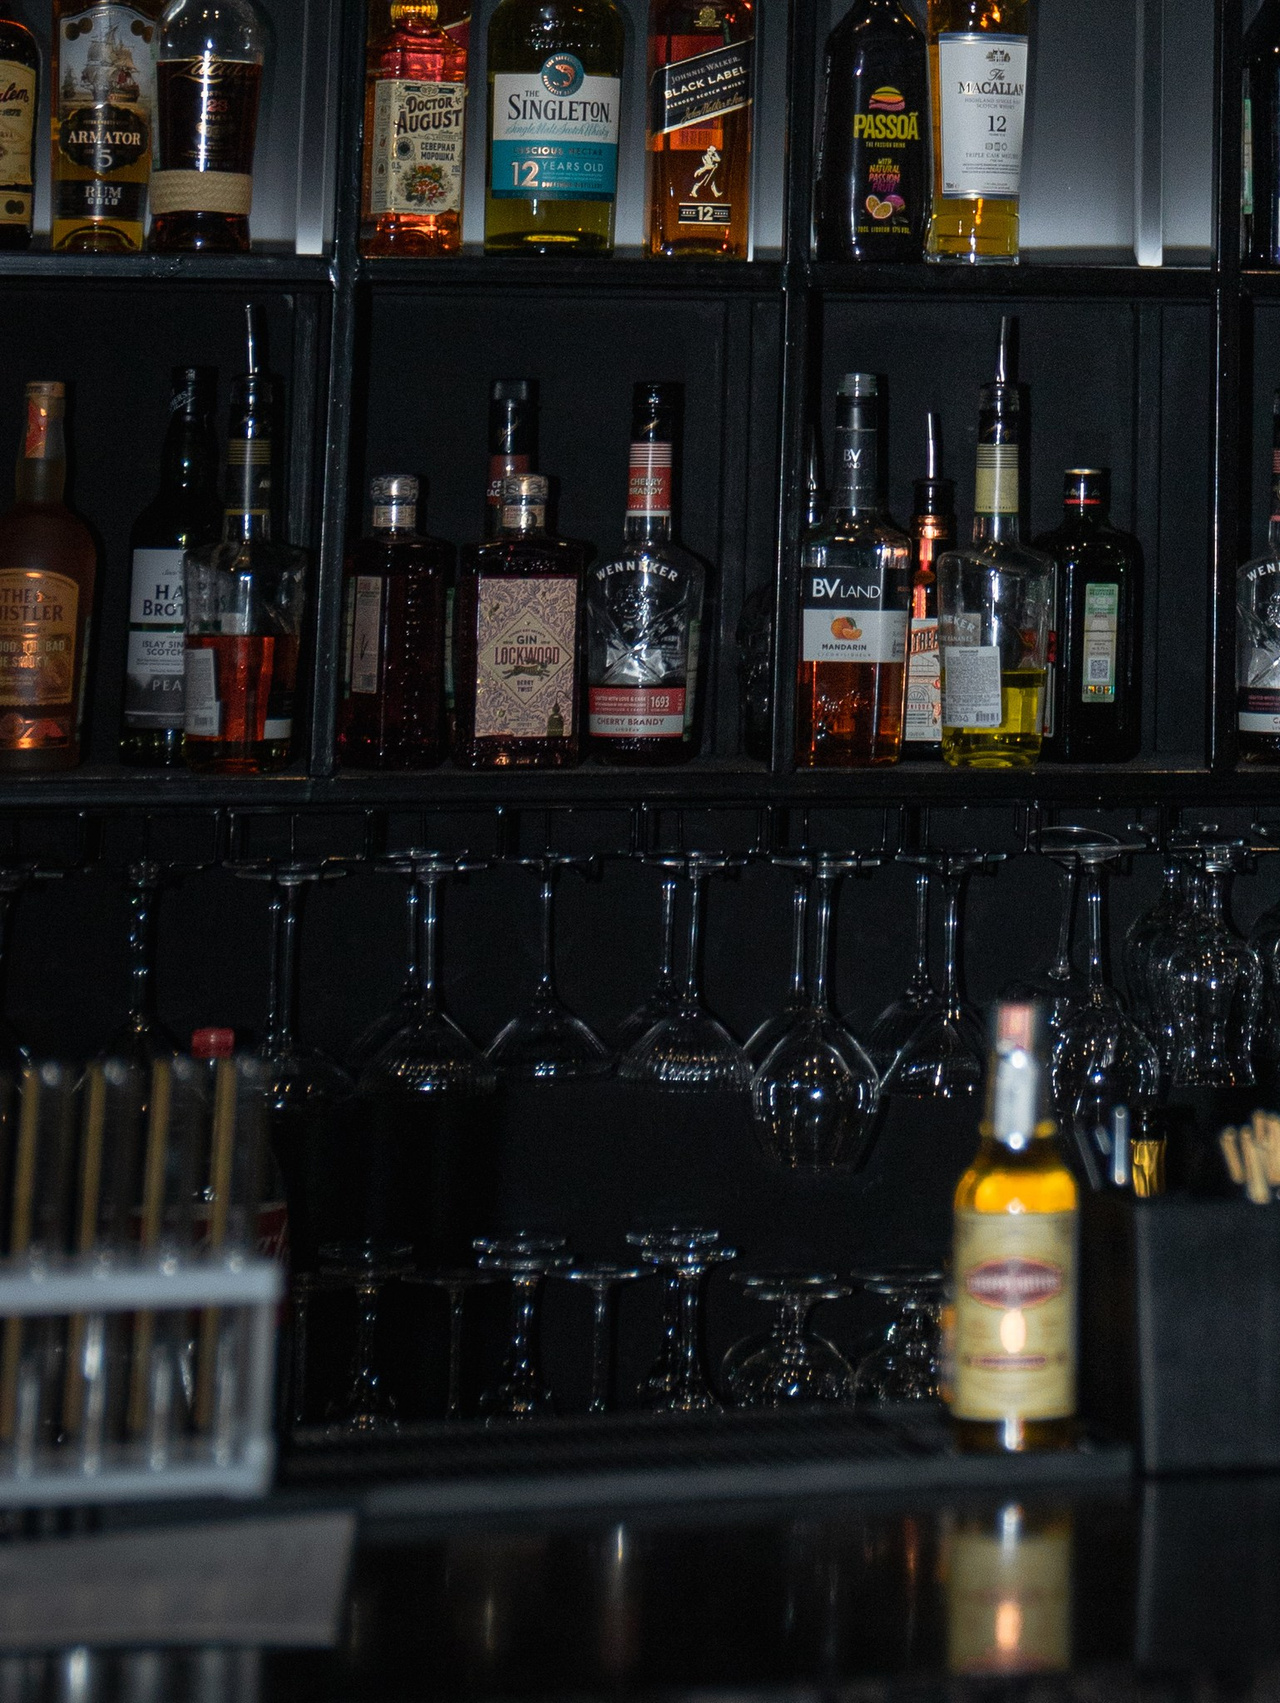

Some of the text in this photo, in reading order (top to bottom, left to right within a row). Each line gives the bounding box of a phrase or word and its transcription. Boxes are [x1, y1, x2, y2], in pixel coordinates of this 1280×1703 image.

[670, 67, 706, 84] JOHNNIE
[987, 68, 1006, 81] The
[664, 66, 747, 100] BLACK LABEL
[958, 81, 1024, 96] MACALLAN
[525, 90, 540, 98] THE
[405, 95, 454, 114] DOCTOR
[666, 97, 695, 109] BLENDED
[394, 109, 463, 136] AUGUST
[853, 112, 919, 140] PASSOÃ
[988, 116, 1007, 132] 12
[68, 130, 141, 145] ARMATOR
[420, 142, 456, 152] СЕВЕРНАЯ
[513, 146, 603, 156] LUSCIOUS NECTAR
[98, 149, 113, 167] 5
[420, 152, 455, 162] МОРОШКА
[511, 160, 539, 187] 12
[541, 161, 580, 171] YEARS
[583, 162, 604, 172] OLD
[869, 164, 901, 173] NATURAL
[85, 186, 122, 199] RUM
[87, 198, 119, 206] GOLD
[697, 206, 714, 221] 12
[596, 559, 679, 582] WENNEKER
[1, 587, 33, 604] THE
[812, 578, 881, 599] BV LAND
[142, 640, 166, 648] ISLAY
[516, 635, 538, 645] GIN
[821, 643, 867, 651] MANDARIN
[494, 646, 561, 665] LOCKWOOD
[650, 695, 670, 708] 1693
[597, 717, 665, 726] CHERRY BRANDY
